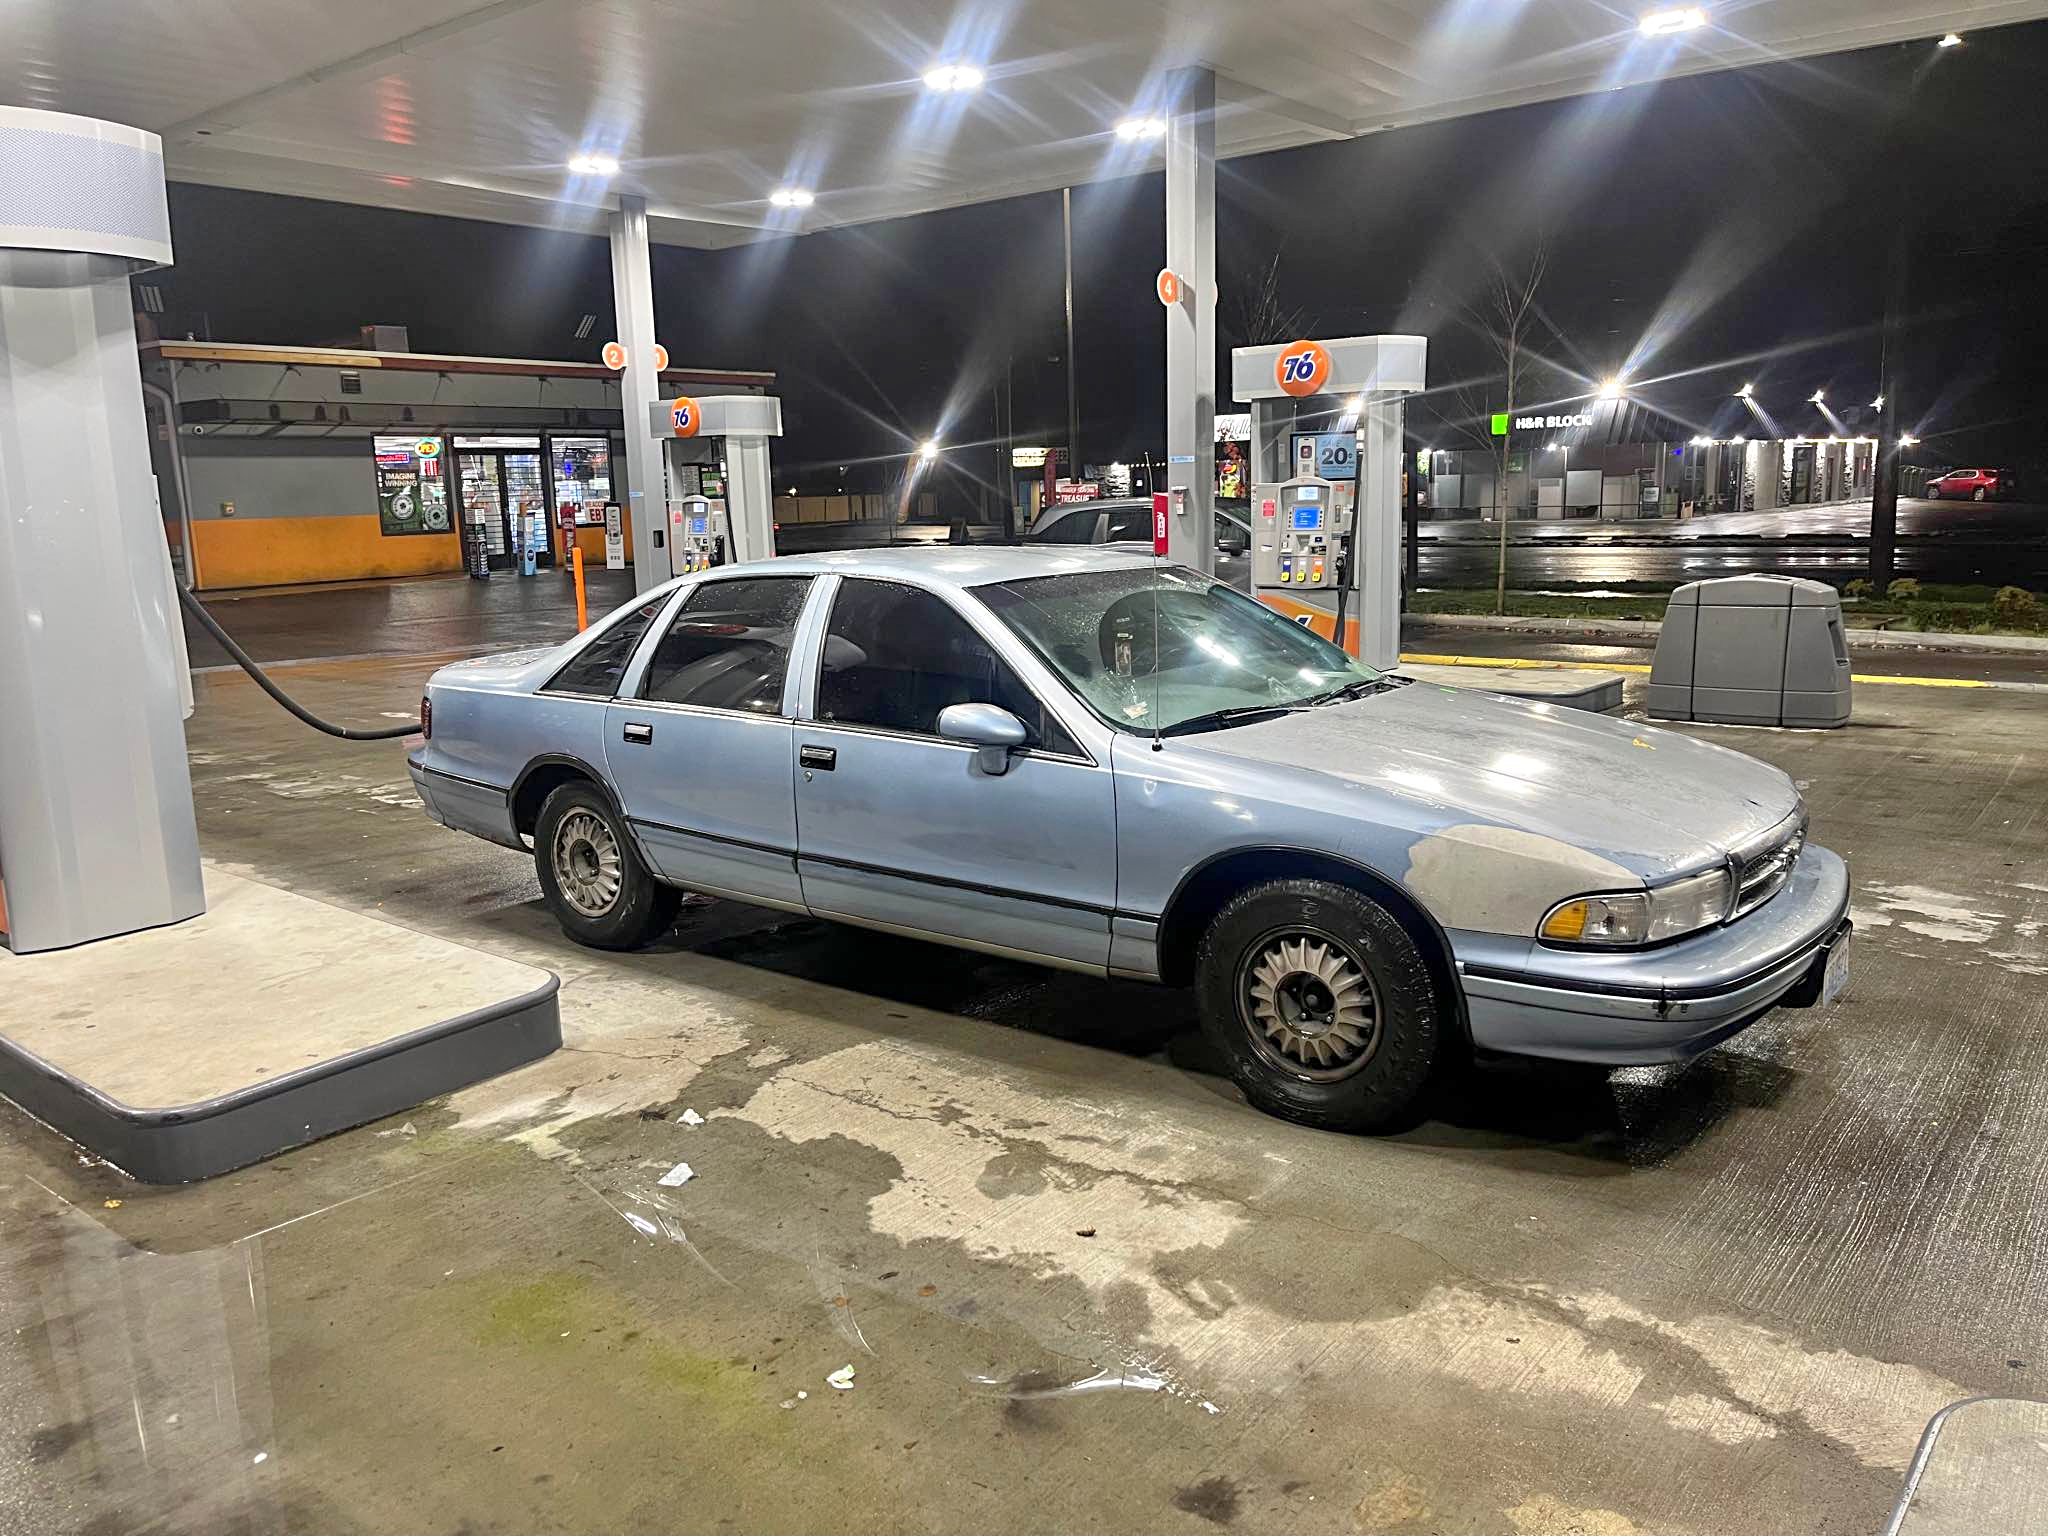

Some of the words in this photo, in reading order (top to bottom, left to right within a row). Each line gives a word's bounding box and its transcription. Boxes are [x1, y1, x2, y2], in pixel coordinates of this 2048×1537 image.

[1164, 279, 1173, 297] 4
[609, 350, 619, 363] 2
[1282, 350, 1317, 384] 76
[673, 406, 690, 429] 76
[1515, 417, 1544, 429] H&R
[1546, 414, 1593, 428] BLOCK
[385, 472, 417, 480] IMAGINE
[385, 480, 418, 488] WINNING
